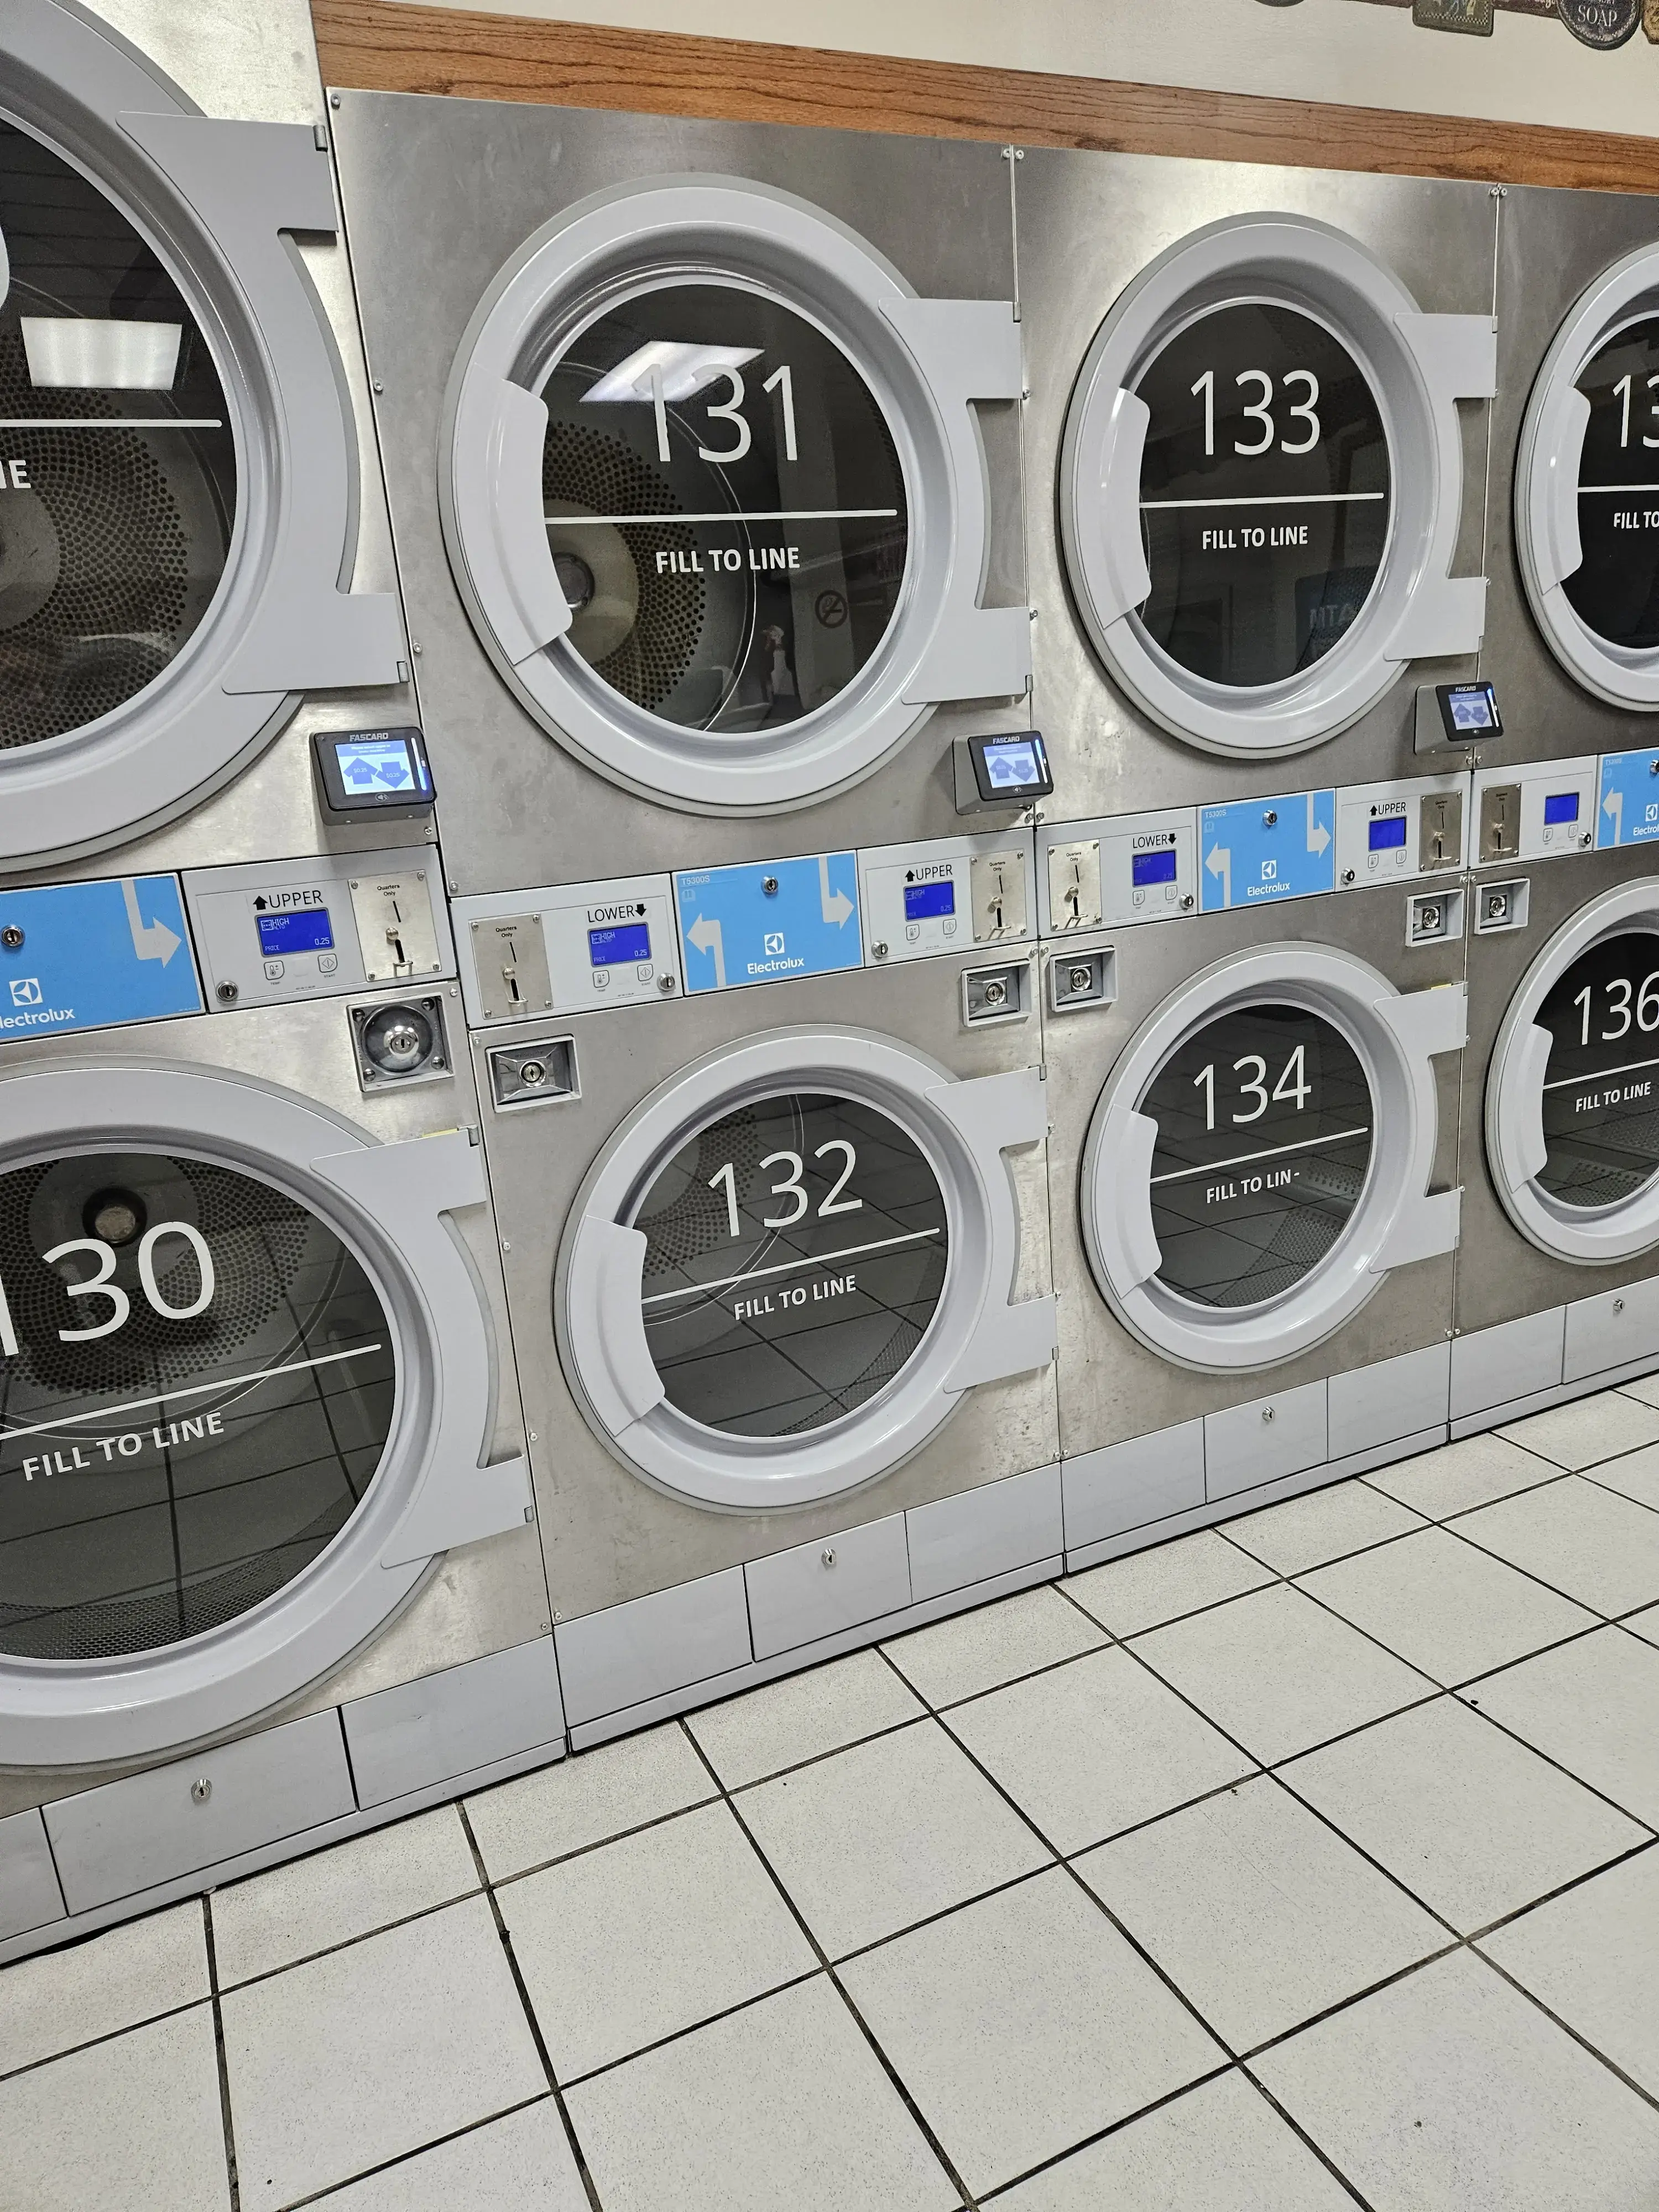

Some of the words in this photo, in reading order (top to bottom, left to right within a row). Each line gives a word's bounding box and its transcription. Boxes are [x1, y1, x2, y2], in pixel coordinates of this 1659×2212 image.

[1578, 4, 1618, 27] SOAP
[632, 363, 797, 462] 131
[1191, 370, 1321, 455] 133
[1613, 375, 1659, 447] 13
[1613, 512, 1640, 529] FILL
[1643, 511, 1659, 528] TO
[1202, 529, 1237, 549] FILL
[1241, 528, 1265, 547] TO
[1270, 526, 1308, 546] LINE
[656, 550, 704, 573] FILL
[708, 549, 742, 571] TO
[749, 547, 800, 570] LINE
[349, 733, 389, 742] FASCARD
[1205, 809, 1227, 818] T5300S
[1378, 802, 1406, 815] UPPER
[1633, 824, 1659, 836] Electrol
[1133, 834, 1167, 848] LOWER
[681, 875, 710, 885] T5300S
[916, 864, 953, 880] UPPER
[1247, 882, 1290, 896] Electrolux
[269, 890, 323, 908] UPPER
[272, 918, 289, 926] HIGH
[587, 905, 635, 923] LOWER
[315, 937, 330, 946] 0.25
[747, 957, 805, 975] Electrolux
[1574, 971, 1659, 1045] 136
[0, 1009, 76, 1029] lectrolux
[1193, 1045, 1311, 1130] 134
[1575, 1094, 1600, 1112] FILL
[1604, 1089, 1620, 1105] TO
[1624, 1081, 1652, 1100] LINE
[708, 1140, 862, 1237] 132
[1207, 1183, 1237, 1203] FILL
[1240, 1177, 1261, 1194] TO
[1266, 1169, 1300, 1188] LIN
[734, 1296, 774, 1321] FILL
[779, 1288, 806, 1308] TO
[813, 1275, 857, 1300] LINE
[22, 1446, 91, 1481] FILL
[96, 1432, 143, 1462] TO
[152, 1412, 224, 1448] LINE
